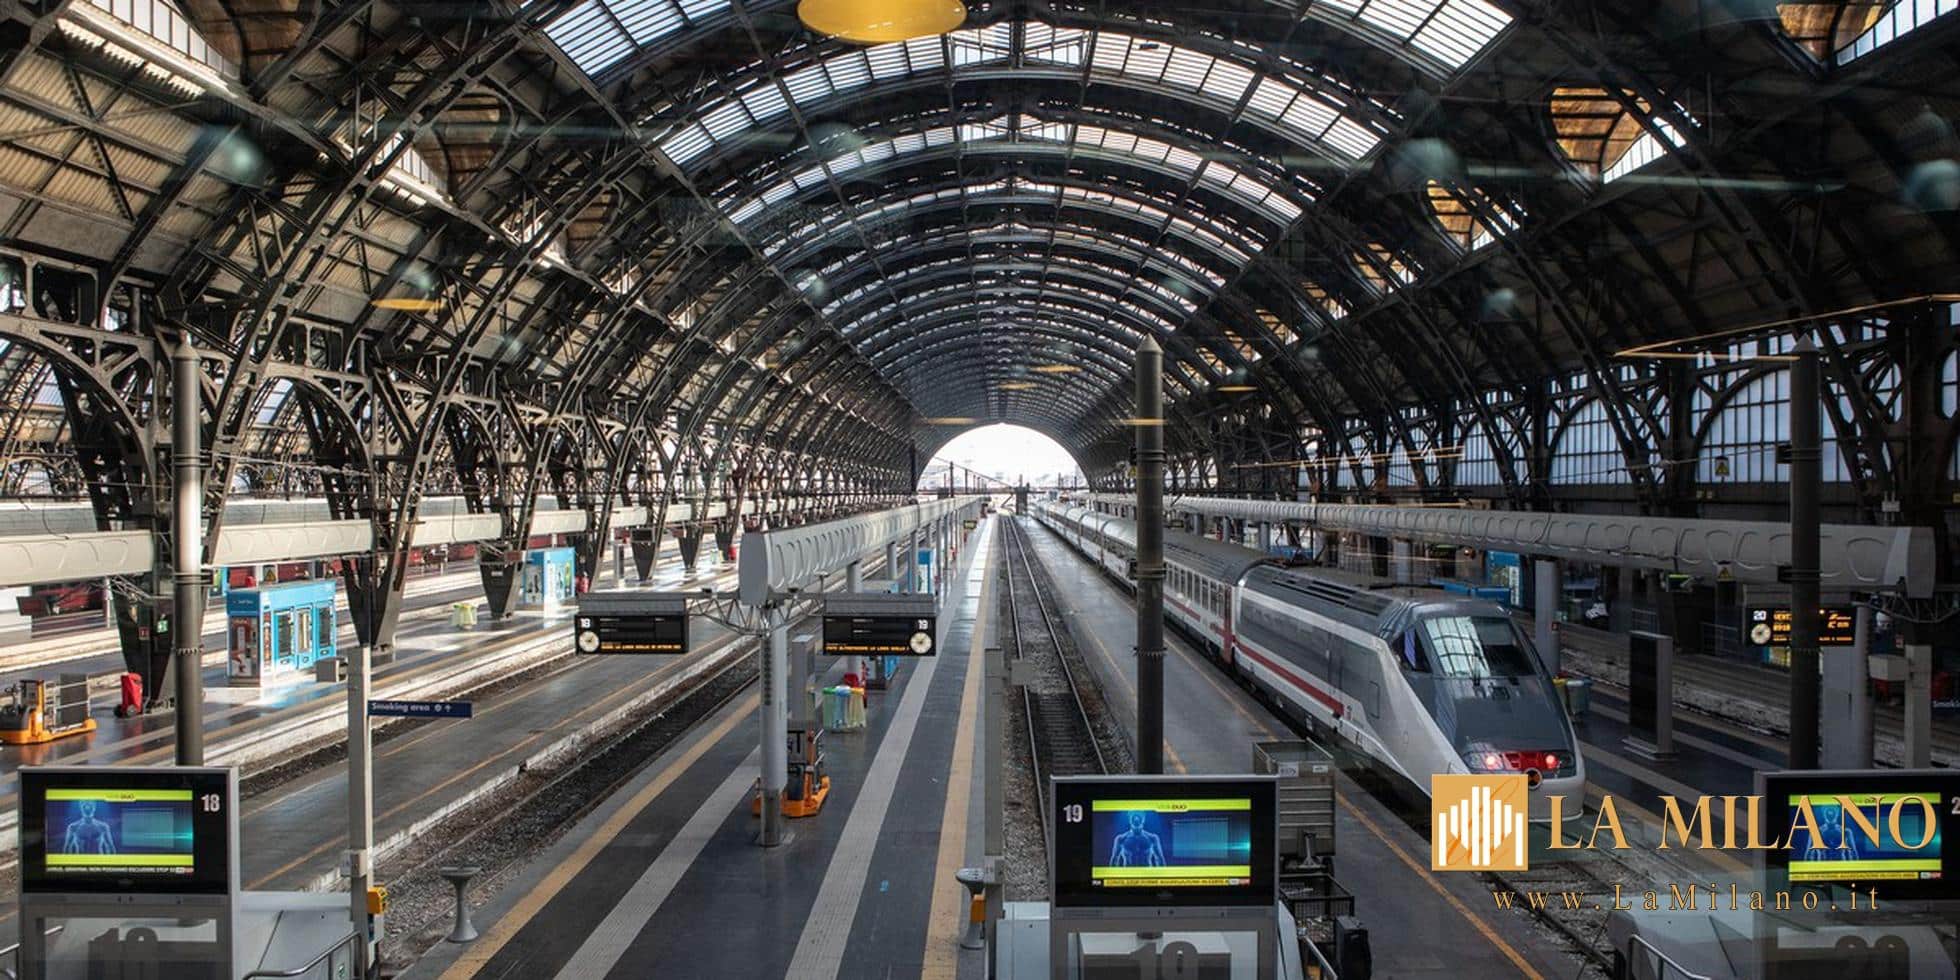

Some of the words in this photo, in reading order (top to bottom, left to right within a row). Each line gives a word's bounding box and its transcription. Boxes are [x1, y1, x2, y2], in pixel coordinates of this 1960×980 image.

[1753, 610, 1767, 621] 20
[372, 702, 409, 713] Smoking
[410, 704, 430, 712] area
[200, 793, 220, 811] 18
[1063, 804, 1083, 823] 19
